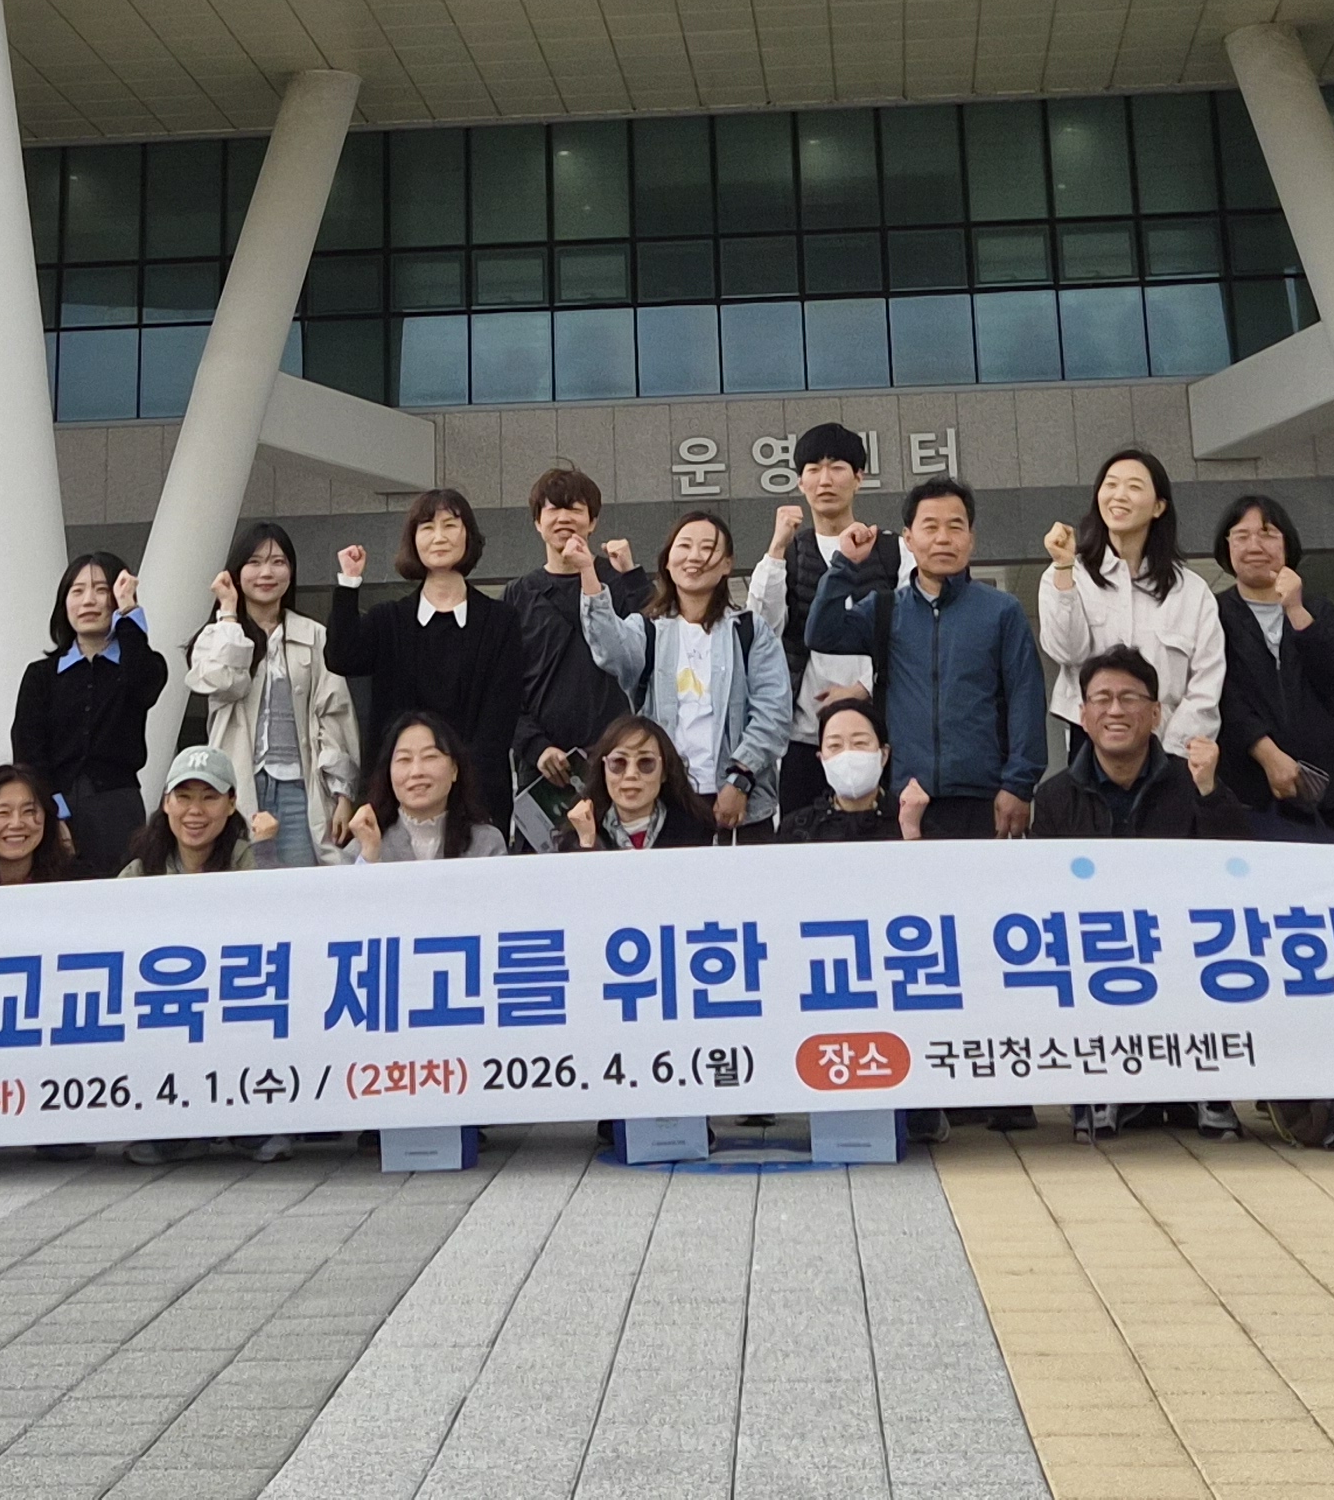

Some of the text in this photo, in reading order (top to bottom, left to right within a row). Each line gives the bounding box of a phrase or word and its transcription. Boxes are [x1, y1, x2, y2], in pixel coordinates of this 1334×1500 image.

[323, 929, 569, 1032] 제고를
[603, 920, 767, 1022] 위한
[799, 914, 964, 1012] 교원
[993, 910, 1163, 1006] 역량
[314, 1064, 332, 1100] /
[345, 1057, 468, 1100] (2회차)
[818, 1041, 893, 1085] 장소
[924, 1031, 1258, 1080] 국립청소년생태센터
